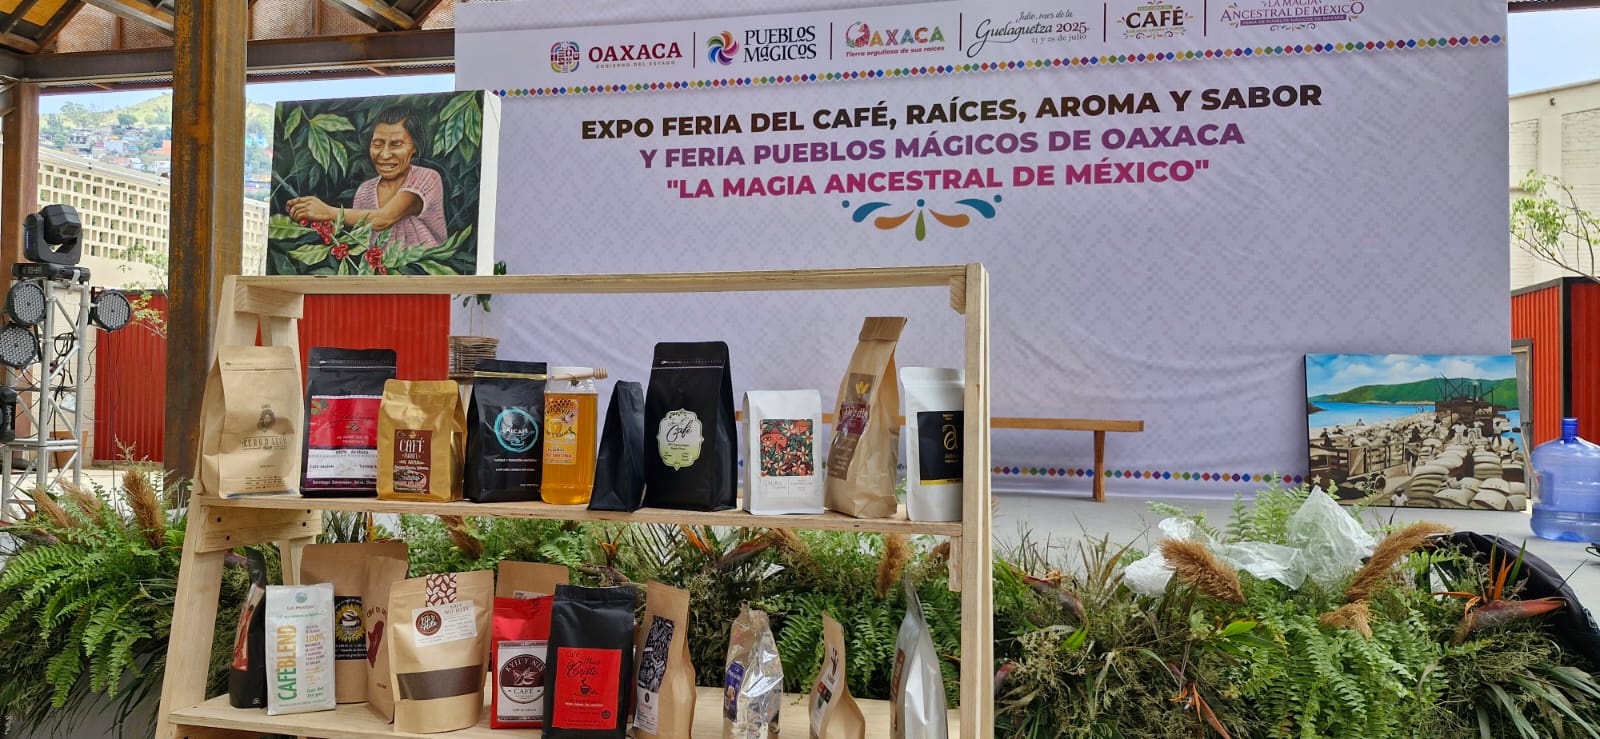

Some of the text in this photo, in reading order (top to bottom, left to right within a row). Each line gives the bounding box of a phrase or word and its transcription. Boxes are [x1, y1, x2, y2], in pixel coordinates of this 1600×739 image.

[1125, 6, 1184, 28] CAFÉ
[1220, 9, 1293, 22] ANCESTRAL
[1295, 6, 1310, 16] DE
[967, 18, 1087, 58] Guelaguetza 2025
[1069, 33, 1087, 43] julio
[588, 42, 683, 62] OAXACA
[846, 50, 866, 58] Tierra
[866, 48, 899, 57] orgullosa
[582, 84, 1322, 139] EXPO FERIA DEL CAFÉ, RAÍCES, AROMA Y SABOR
[639, 123, 1245, 168] Y FERIA PUEBLOS MÁGICOS DE OAXACA
[667, 157, 1210, 199] "LA MAGIA ANCESTRAL DE MÉXICO"
[666, 419, 693, 442] Café
[399, 437, 425, 453] CAFÉ
[277, 624, 297, 701] CAFEBLEND
